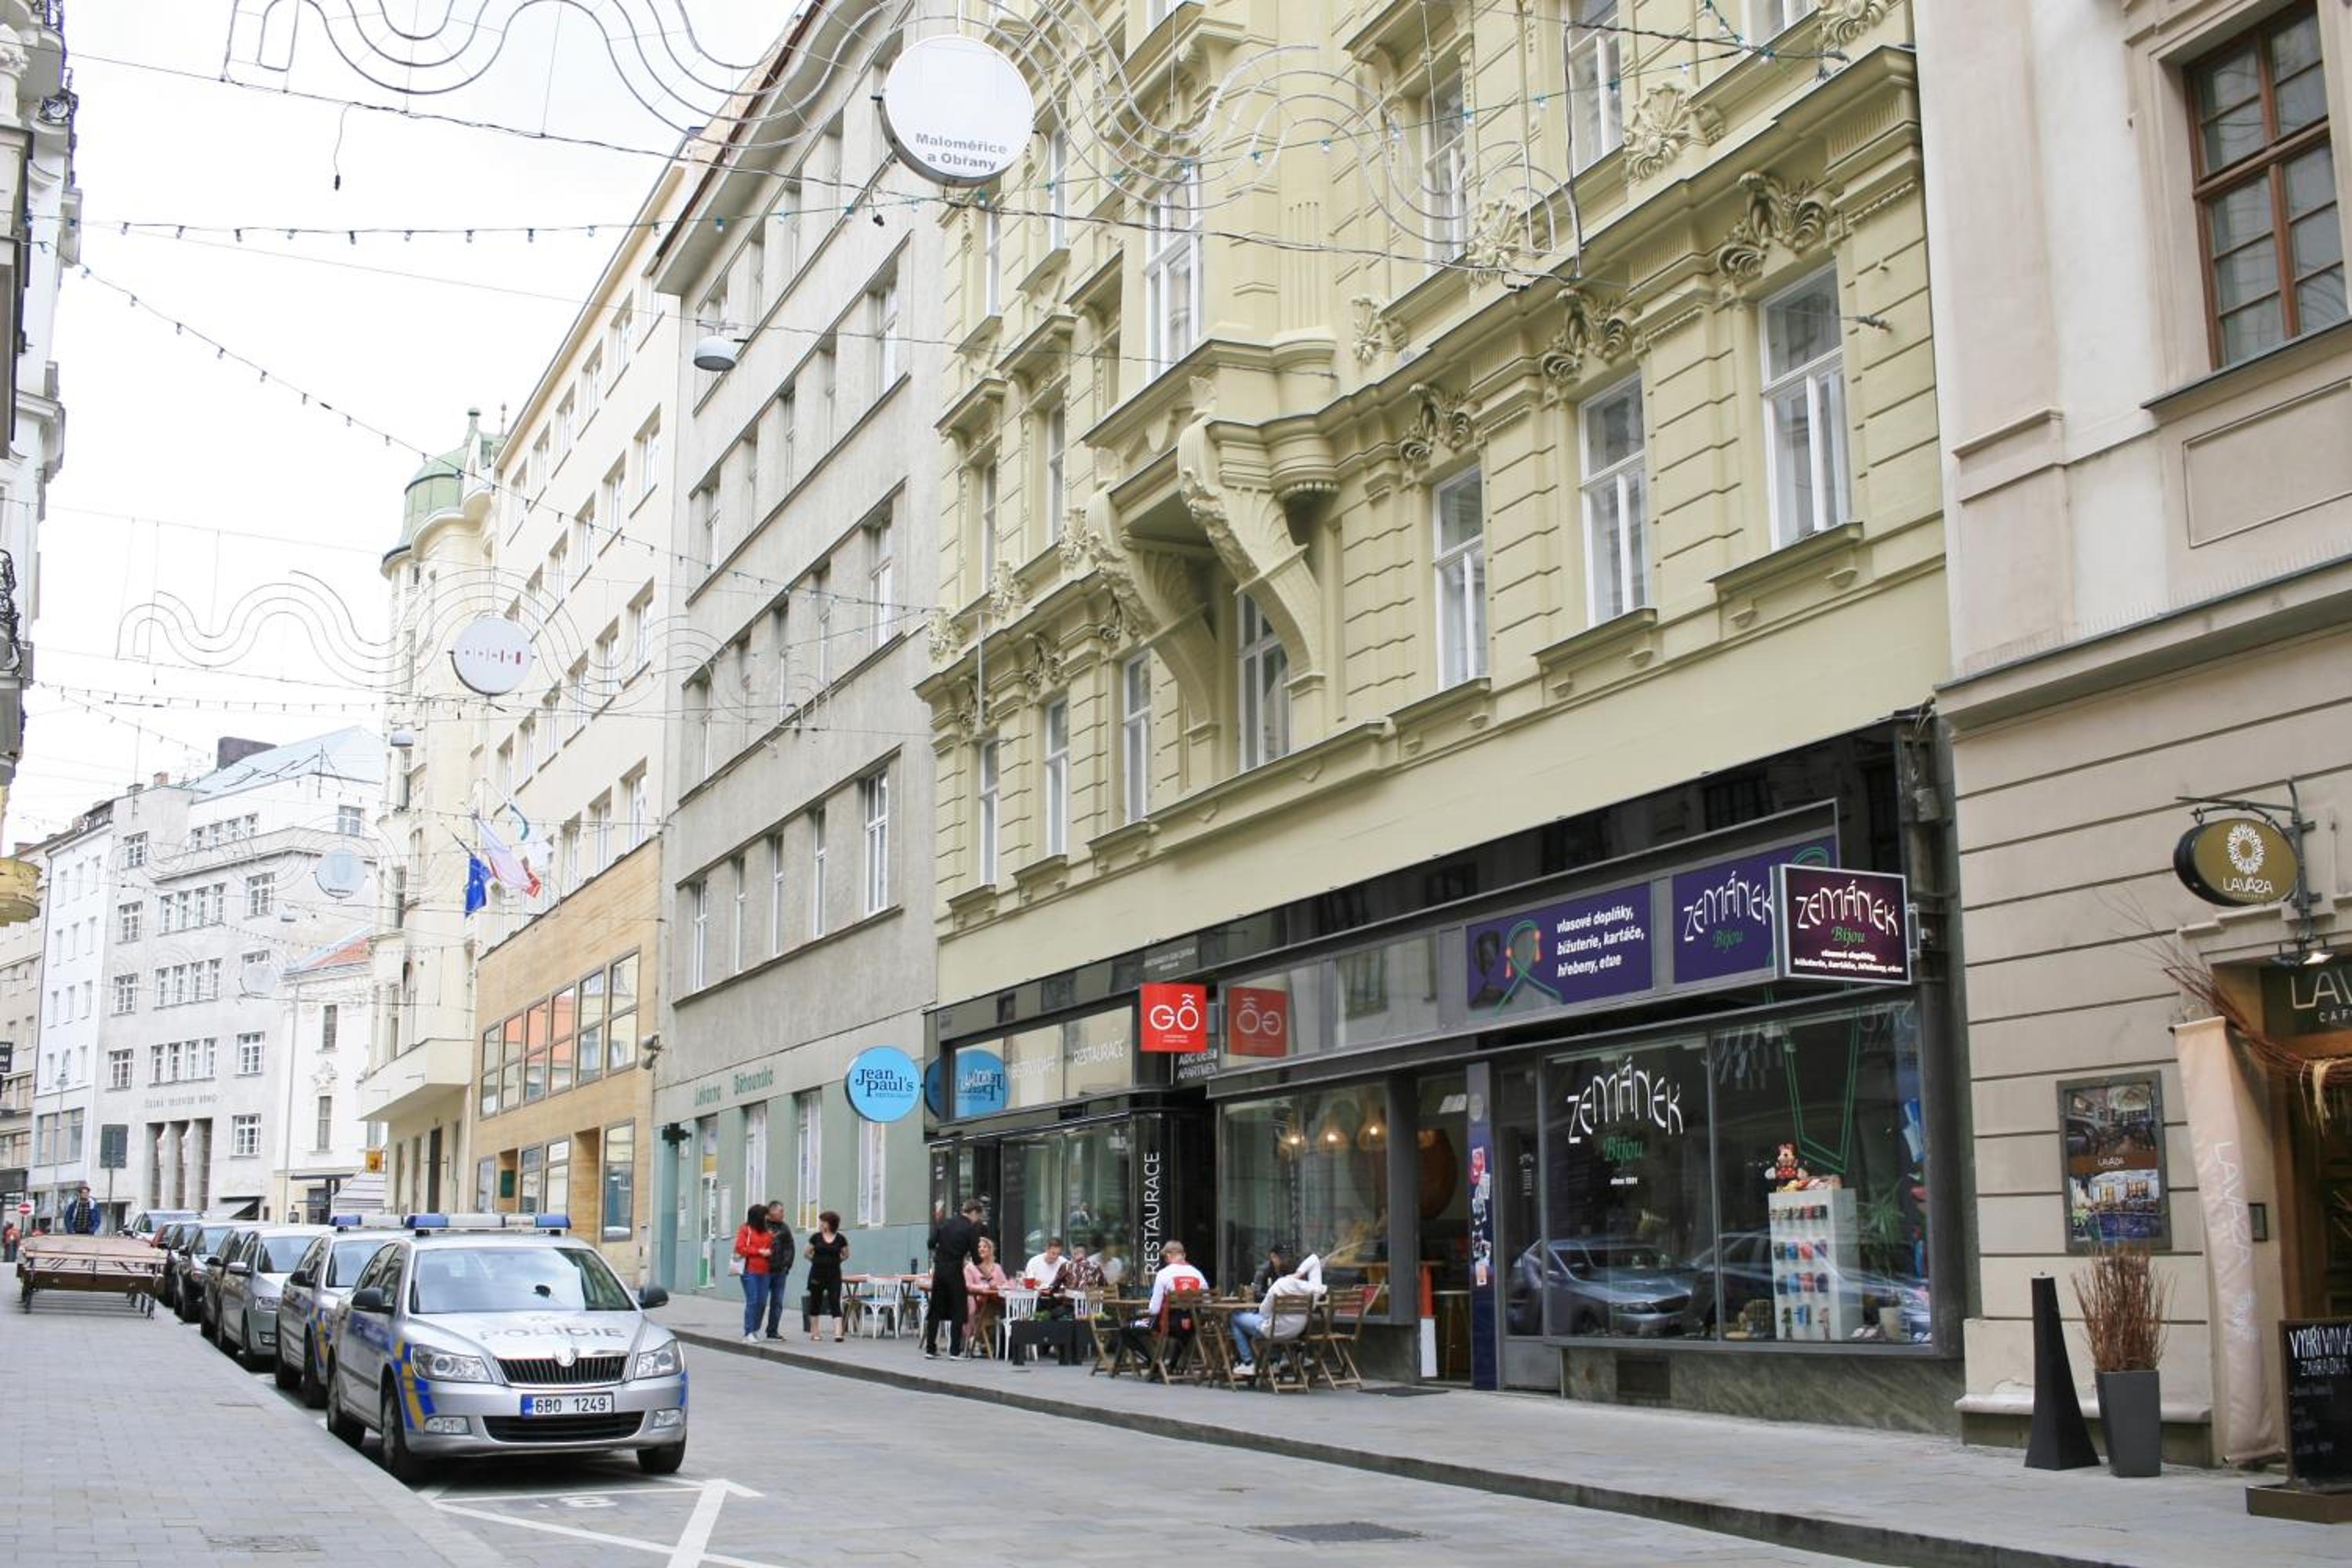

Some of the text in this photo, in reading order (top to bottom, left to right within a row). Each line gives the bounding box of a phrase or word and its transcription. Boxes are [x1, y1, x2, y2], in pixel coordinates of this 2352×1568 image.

[927, 153, 937, 162] a
[1556, 905, 1634, 933] vlasové doplňky,
[1795, 879, 1898, 937] ZEMÁNEK
[1556, 926, 1645, 955] bižuterie, kartáče,
[1831, 926, 1865, 947] Bijou
[1556, 960, 1599, 978] hřebeny,
[855, 1068, 894, 1086] Jean
[1567, 1054, 1684, 1144] ZEMÁNEK
[1605, 1136, 1644, 1167] Bijou
[1144, 1152, 1160, 1276] RESTAURACE
[574, 1396, 606, 1413] 1249
